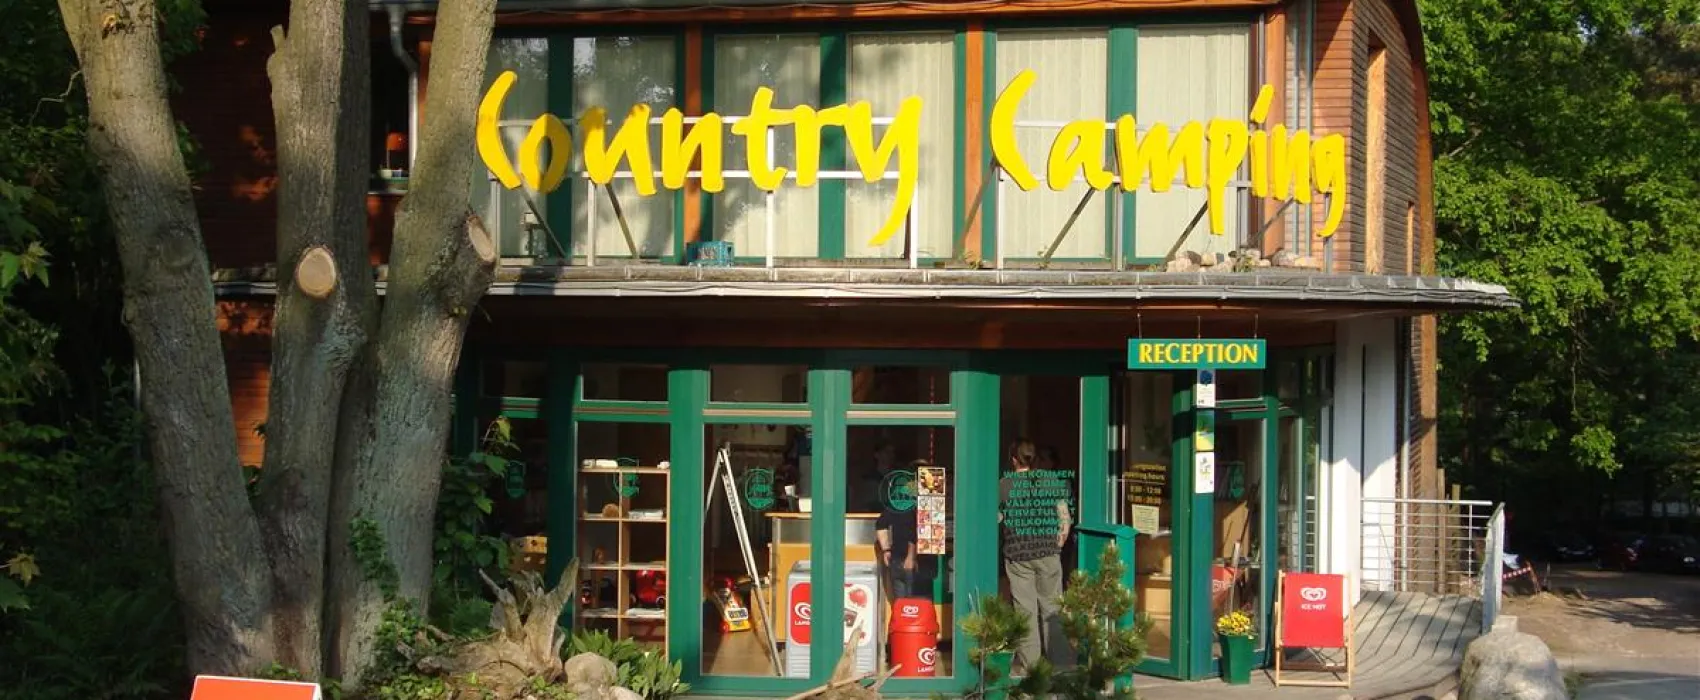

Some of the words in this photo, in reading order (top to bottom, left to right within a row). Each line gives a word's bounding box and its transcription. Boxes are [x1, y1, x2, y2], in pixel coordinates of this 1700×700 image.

[476, 71, 922, 247] Country
[990, 68, 1346, 240] Camping
[1138, 342, 1258, 364] RECEPTION
